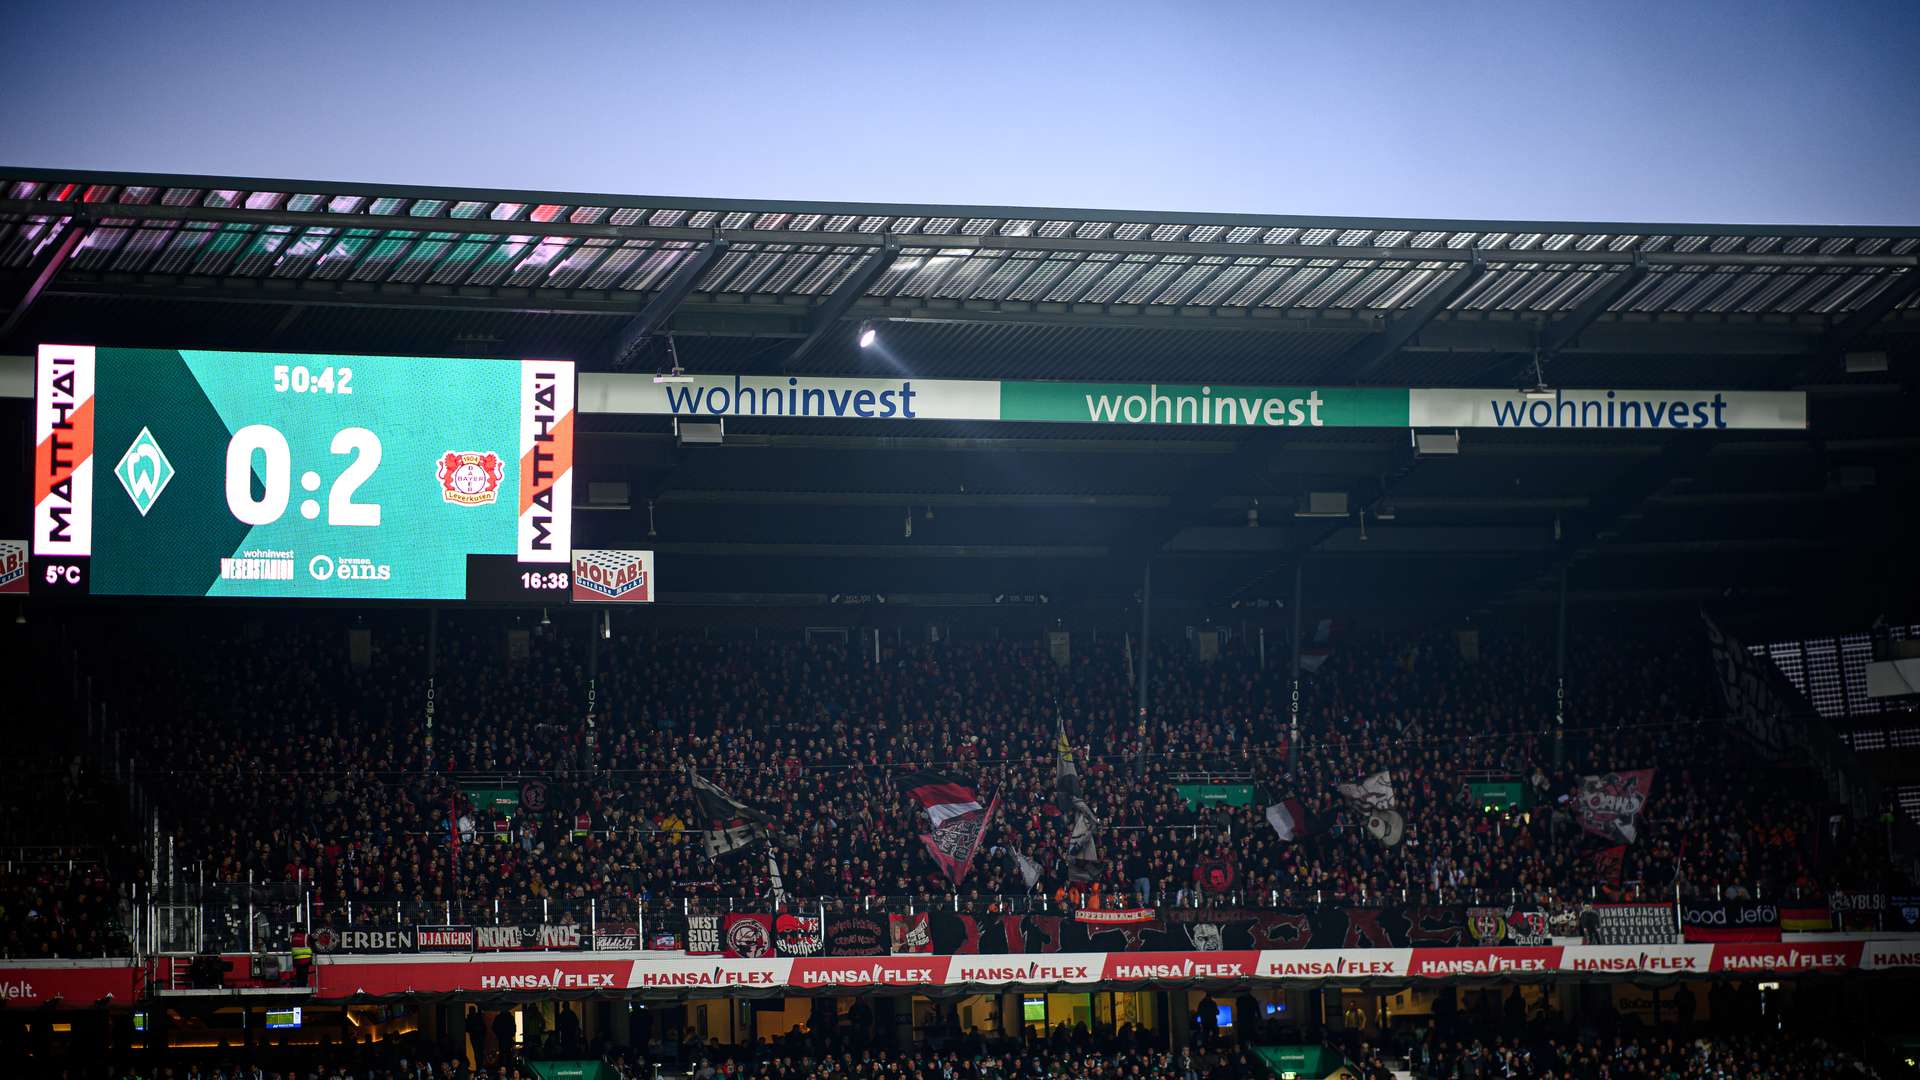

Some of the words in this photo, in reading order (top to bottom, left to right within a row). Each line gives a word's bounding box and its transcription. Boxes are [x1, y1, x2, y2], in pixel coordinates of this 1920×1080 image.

[273, 365, 354, 395] 50:42
[665, 375, 916, 418] wohninvest
[1085, 384, 1324, 426] wohninvest
[1490, 389, 1727, 429] wohninvest
[225, 423, 383, 527] 0:2
[449, 491, 491, 502] Leverkusen
[243, 549, 295, 559] wohninvest
[338, 556, 372, 564] bremen
[45, 565, 81, 585] 5°C
[336, 564, 391, 580] eins
[521, 572, 569, 589] 16:38
[1291, 680, 1299, 713] 103
[687, 916, 719, 929] WEST
[341, 931, 412, 949] ERBEN
[419, 931, 472, 946] DJANGOS
[688, 929, 720, 942] SIDE
[689, 942, 721, 952] BOYZ
[776, 939, 823, 957] Brothers
[1270, 962, 1333, 975] HANSA
[1348, 961, 1394, 974] FLEX
[1422, 960, 1486, 973] HANSA
[1500, 959, 1545, 972] FLEX
[1573, 957, 1636, 971] HANSA
[1650, 956, 1696, 970] FLEX
[1724, 955, 1787, 968] HANSA
[1801, 953, 1847, 967] FLEX
[803, 970, 870, 984] HANSA
[884, 969, 932, 983] FLEX
[960, 967, 1025, 981] HANSA
[1041, 966, 1087, 979] FLEX
[1116, 965, 1180, 978] HANSA
[1195, 963, 1243, 977] FLEX
[482, 975, 551, 988] HANSA
[565, 973, 615, 987] FLEX
[643, 972, 709, 986] HANSA
[725, 971, 774, 985] FLEX
